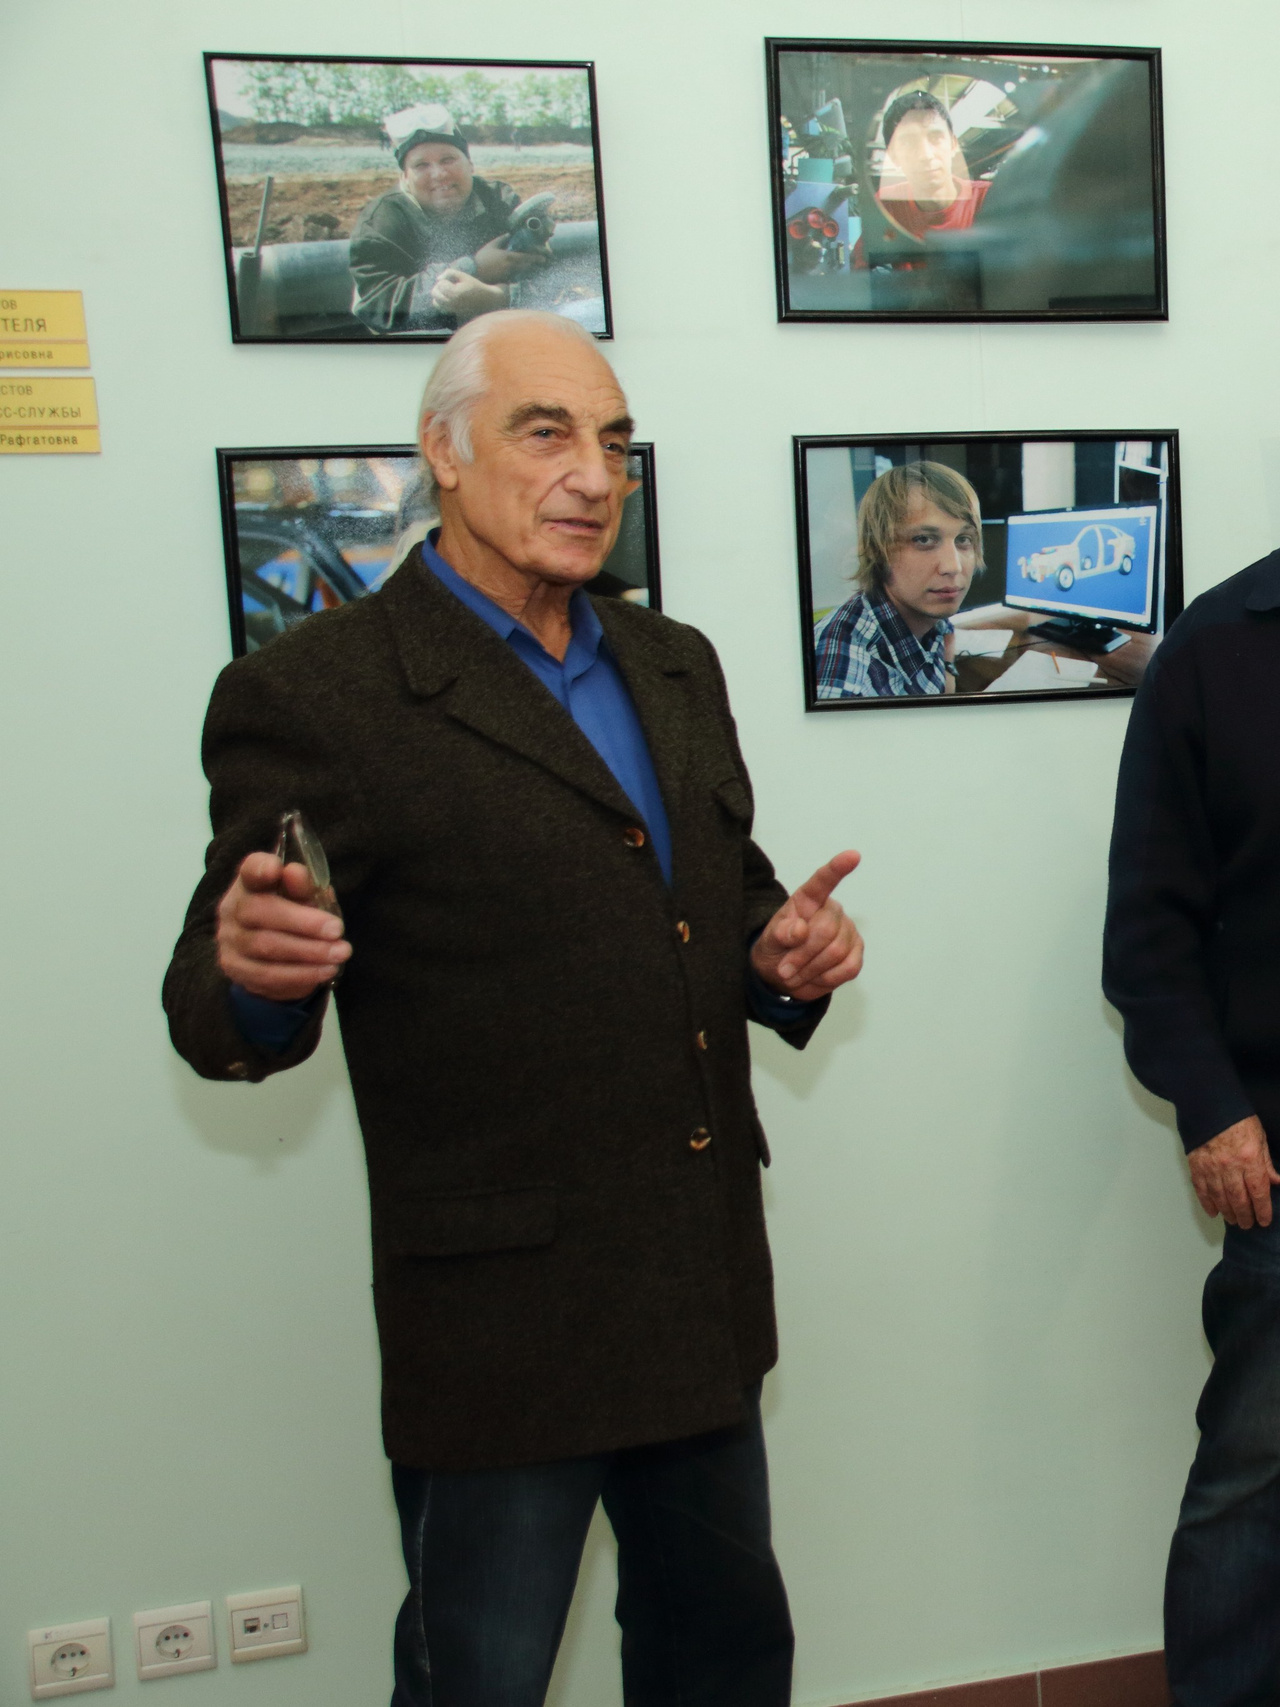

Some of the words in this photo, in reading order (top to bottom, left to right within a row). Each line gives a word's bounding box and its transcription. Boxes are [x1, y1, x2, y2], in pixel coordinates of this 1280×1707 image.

[0, 317, 47, 333] ТЕЛЯ
[0, 385, 33, 395] СТОВ
[0, 433, 79, 447] Рафгатовна
